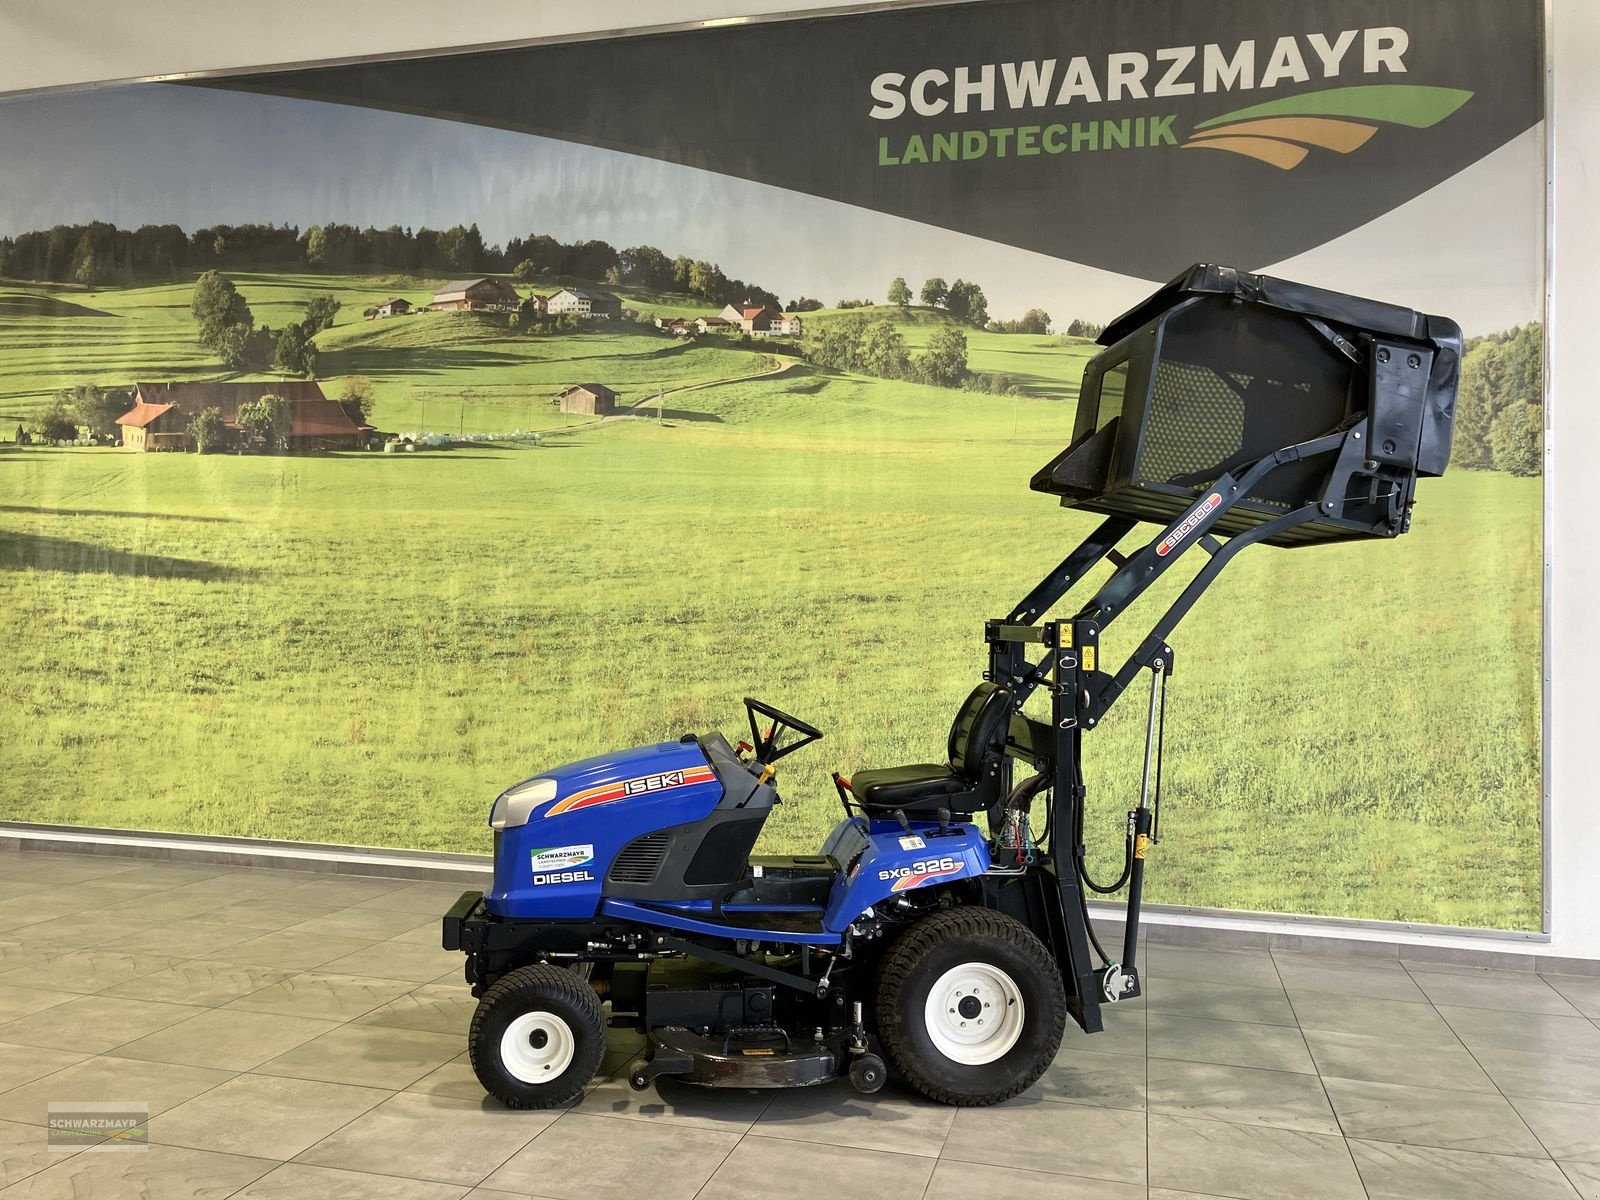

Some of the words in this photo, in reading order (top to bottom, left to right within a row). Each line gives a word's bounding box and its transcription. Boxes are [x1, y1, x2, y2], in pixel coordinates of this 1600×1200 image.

[869, 26, 1410, 121] SCHWARZMAYR
[879, 114, 1179, 167] LANDTECHNIK
[624, 772, 685, 795] ISEKI
[536, 850, 585, 860] SCHWARZMAYR
[533, 870, 594, 885] DIESEL
